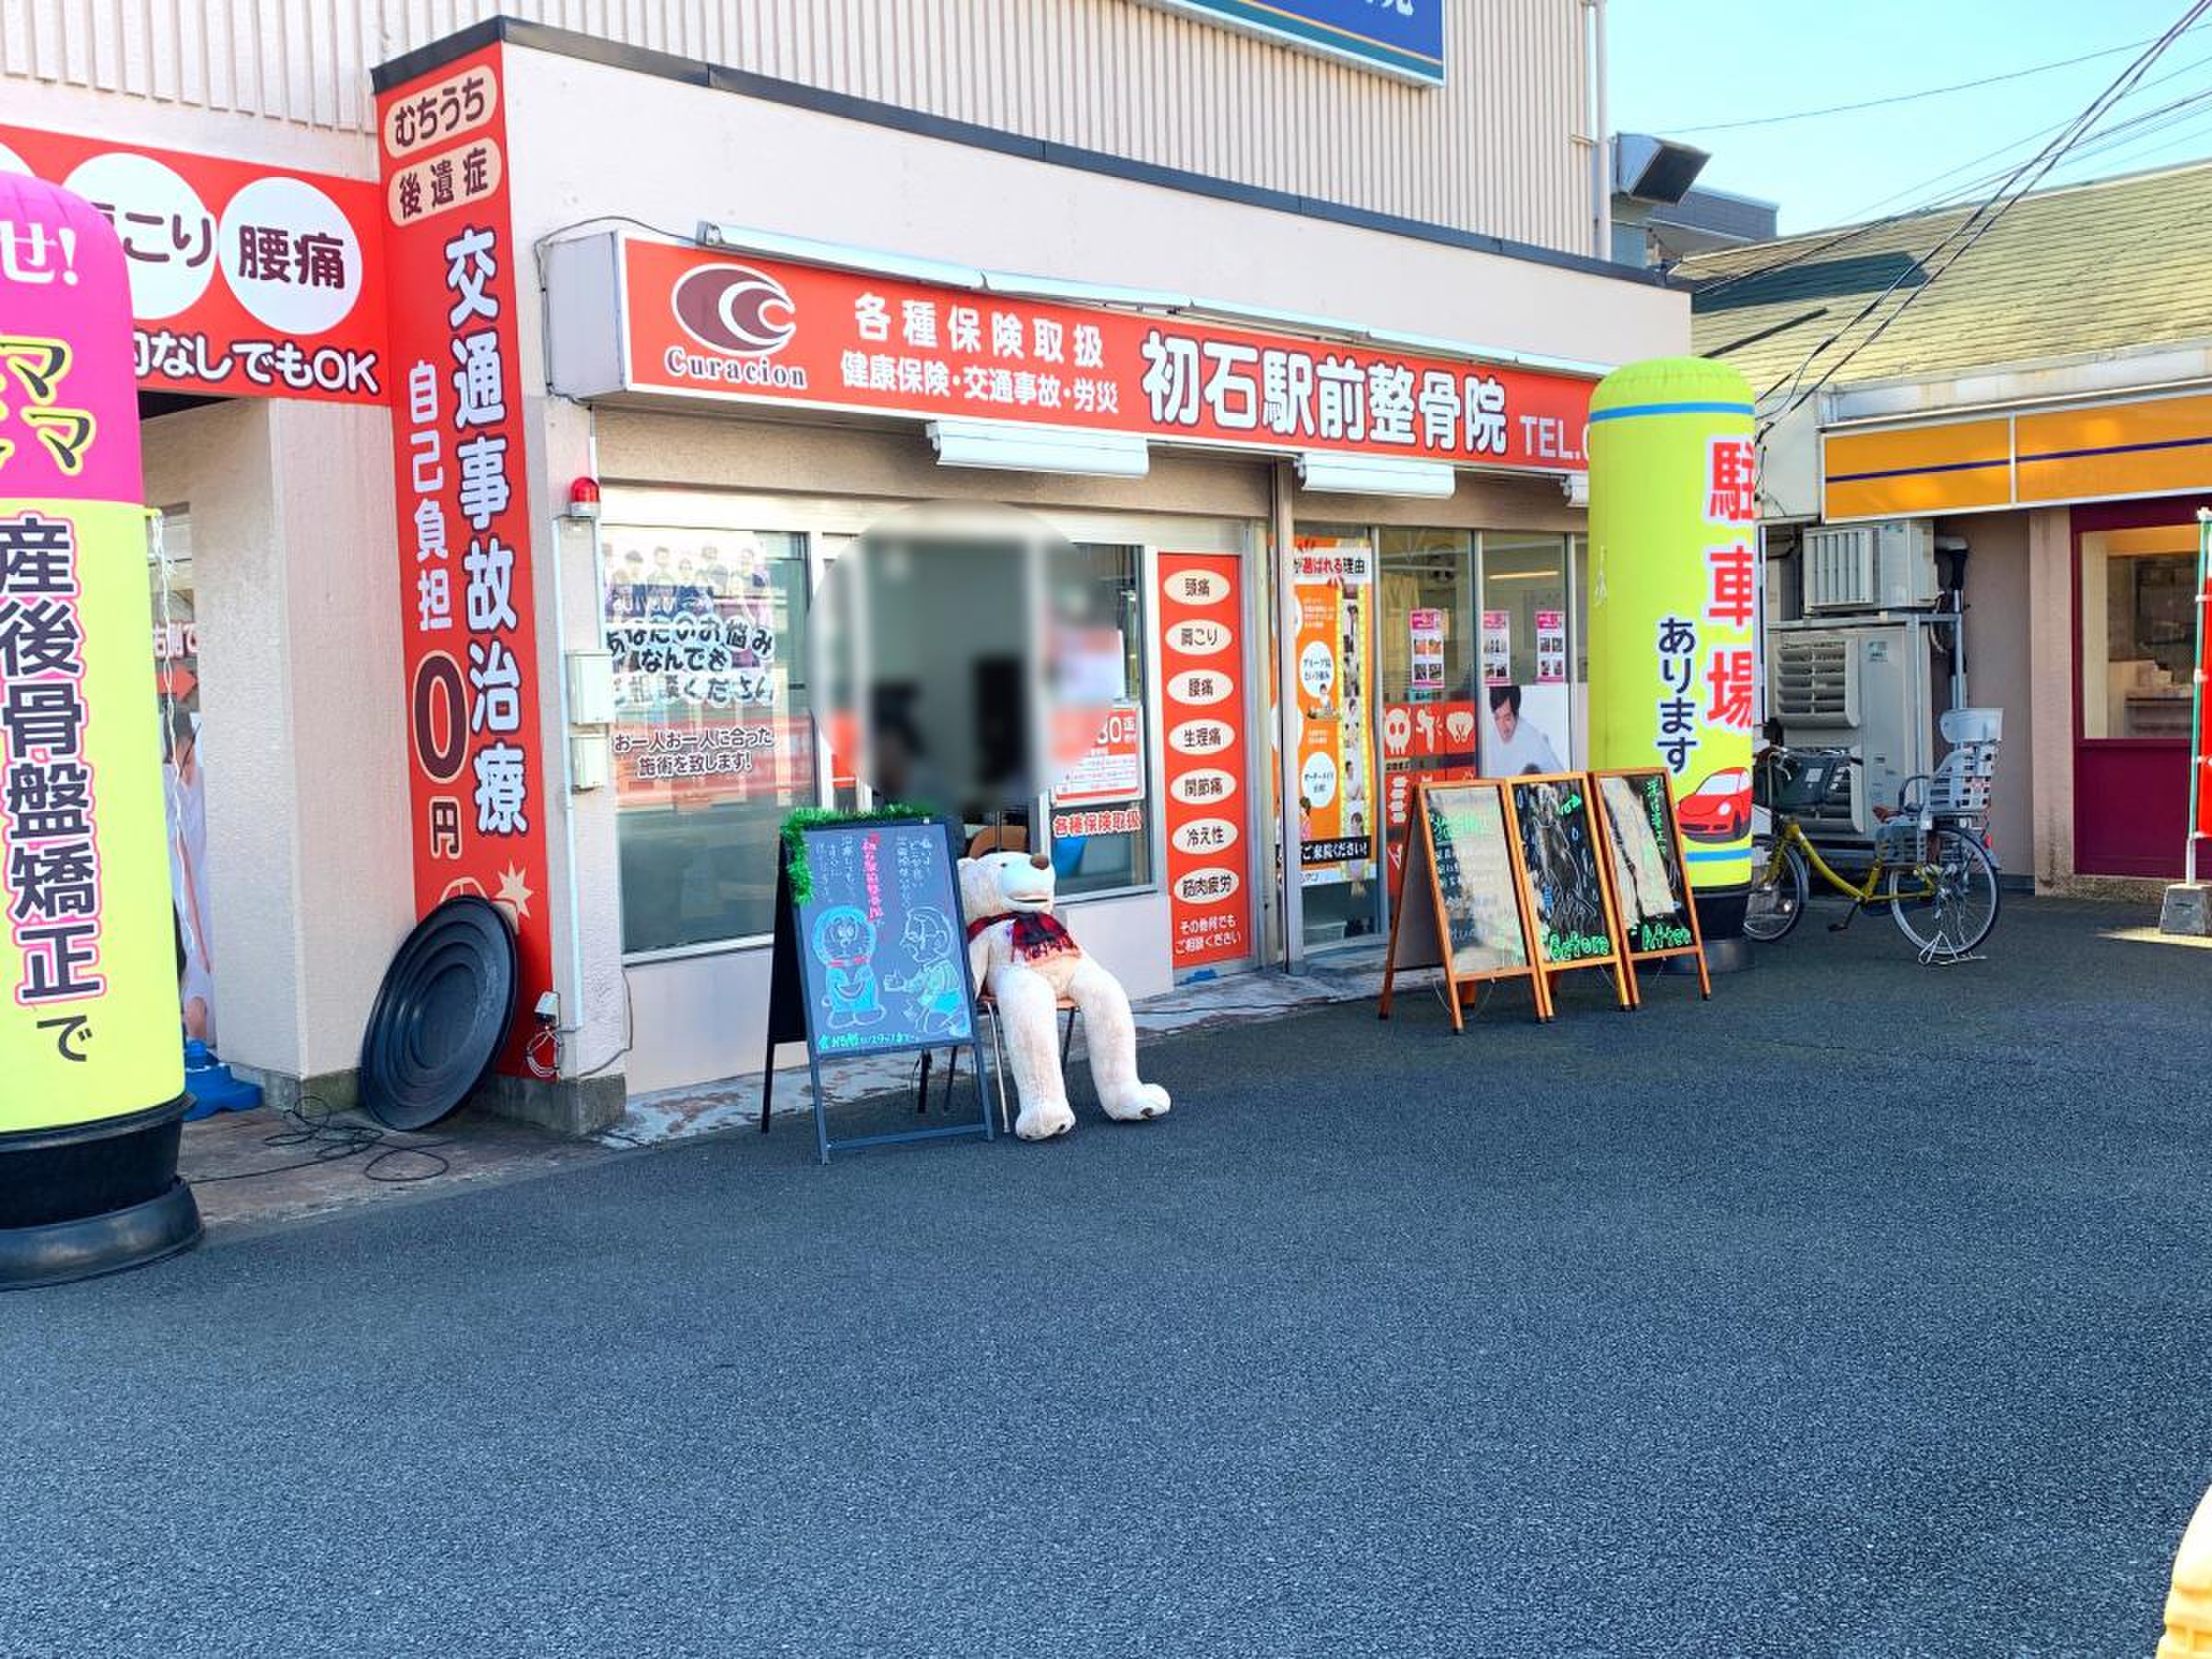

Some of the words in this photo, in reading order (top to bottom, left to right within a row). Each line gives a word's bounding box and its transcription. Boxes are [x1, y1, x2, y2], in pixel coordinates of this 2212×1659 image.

[394, 76, 486, 147] むちうち
[399, 146, 489, 218] 後遺症
[239, 225, 347, 289] 腰痛
[855, 294, 1104, 368] 各種保険取扱
[665, 348, 806, 389] Curacion
[841, 350, 1119, 415] 健康保険・交通事故・労災
[1140, 328, 1508, 453] 初石駅前整骨院
[446, 227, 528, 835] 交通事故治療
[1707, 441, 1753, 729] 駐車場
[1181, 628, 1218, 646] 肩こり
[1659, 617, 1697, 774] あります
[615, 727, 772, 752] お一人お一人に合った
[0, 516, 101, 1063] 産後骨盤矯正で
[1186, 826, 1225, 847] 冷え性
